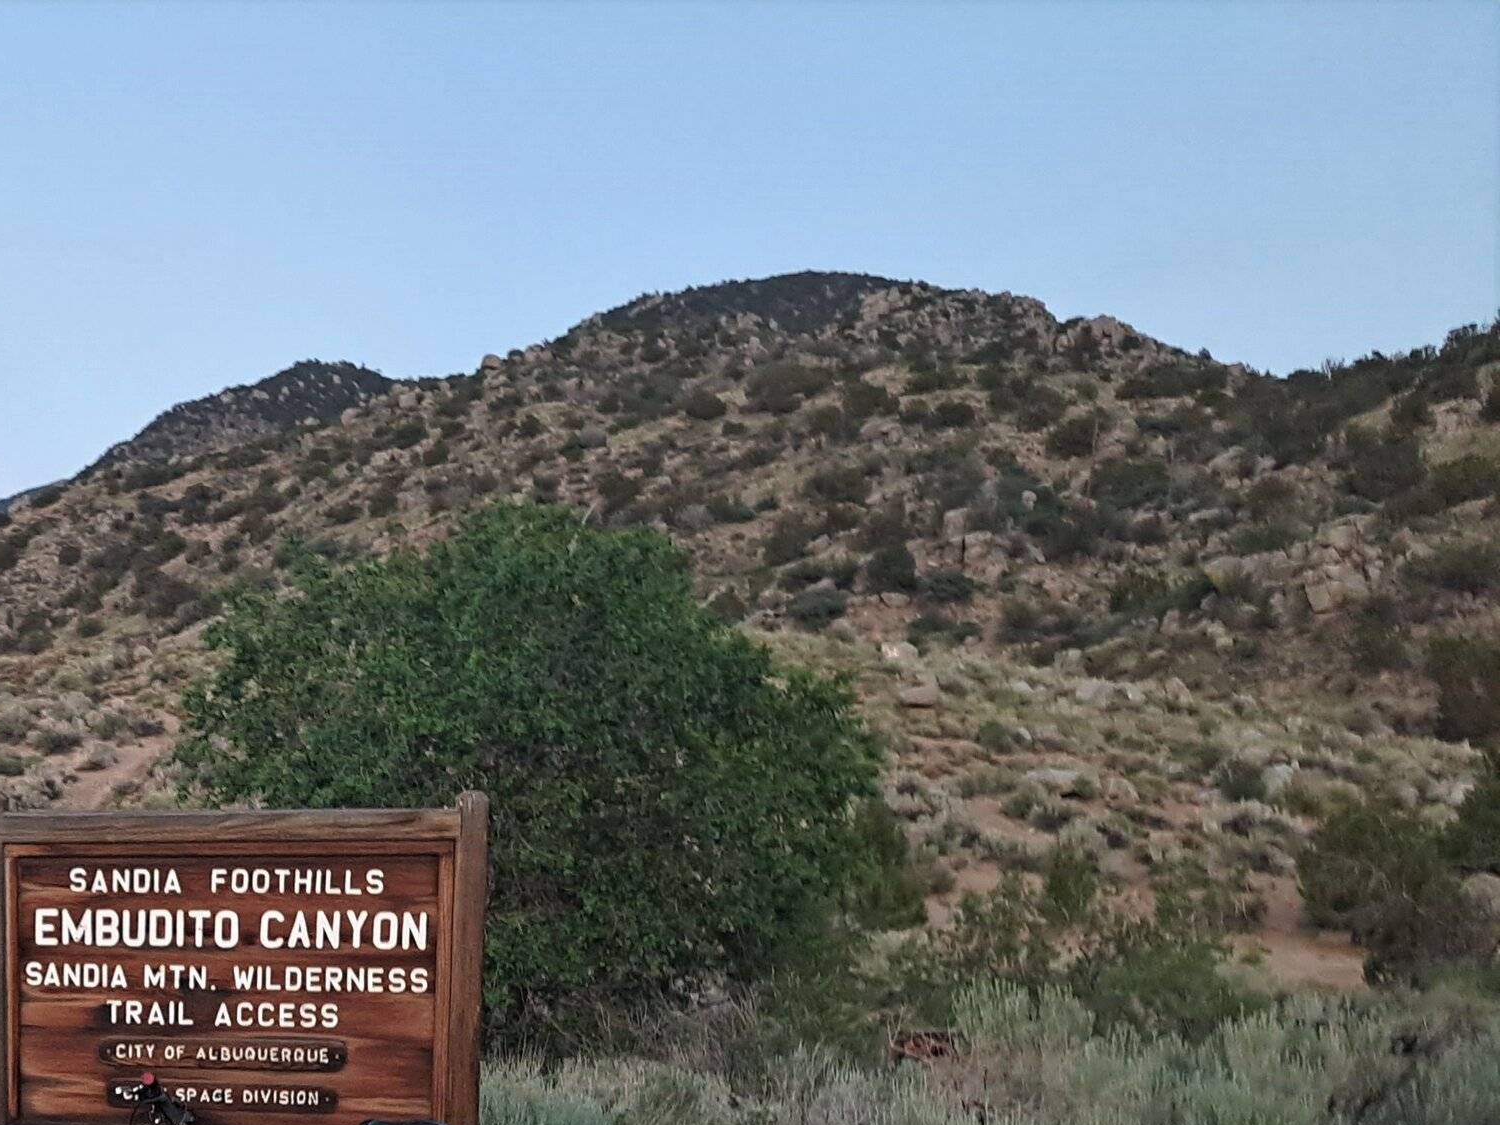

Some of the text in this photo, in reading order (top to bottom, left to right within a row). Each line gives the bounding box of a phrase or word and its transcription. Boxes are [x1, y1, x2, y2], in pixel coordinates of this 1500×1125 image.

[69, 867, 385, 895] SANDIA FOOTHILLS
[34, 908, 428, 951] EMBUDITO CANYON
[25, 960, 429, 993] SANDIA MTN. WILDERNESS
[106, 999, 339, 1028] TRAIL ACCESS
[115, 1043, 329, 1064] CITY OF ALBUQUERQUE
[175, 1087, 233, 1104] SPACE
[242, 1088, 320, 1106] DIVISION
